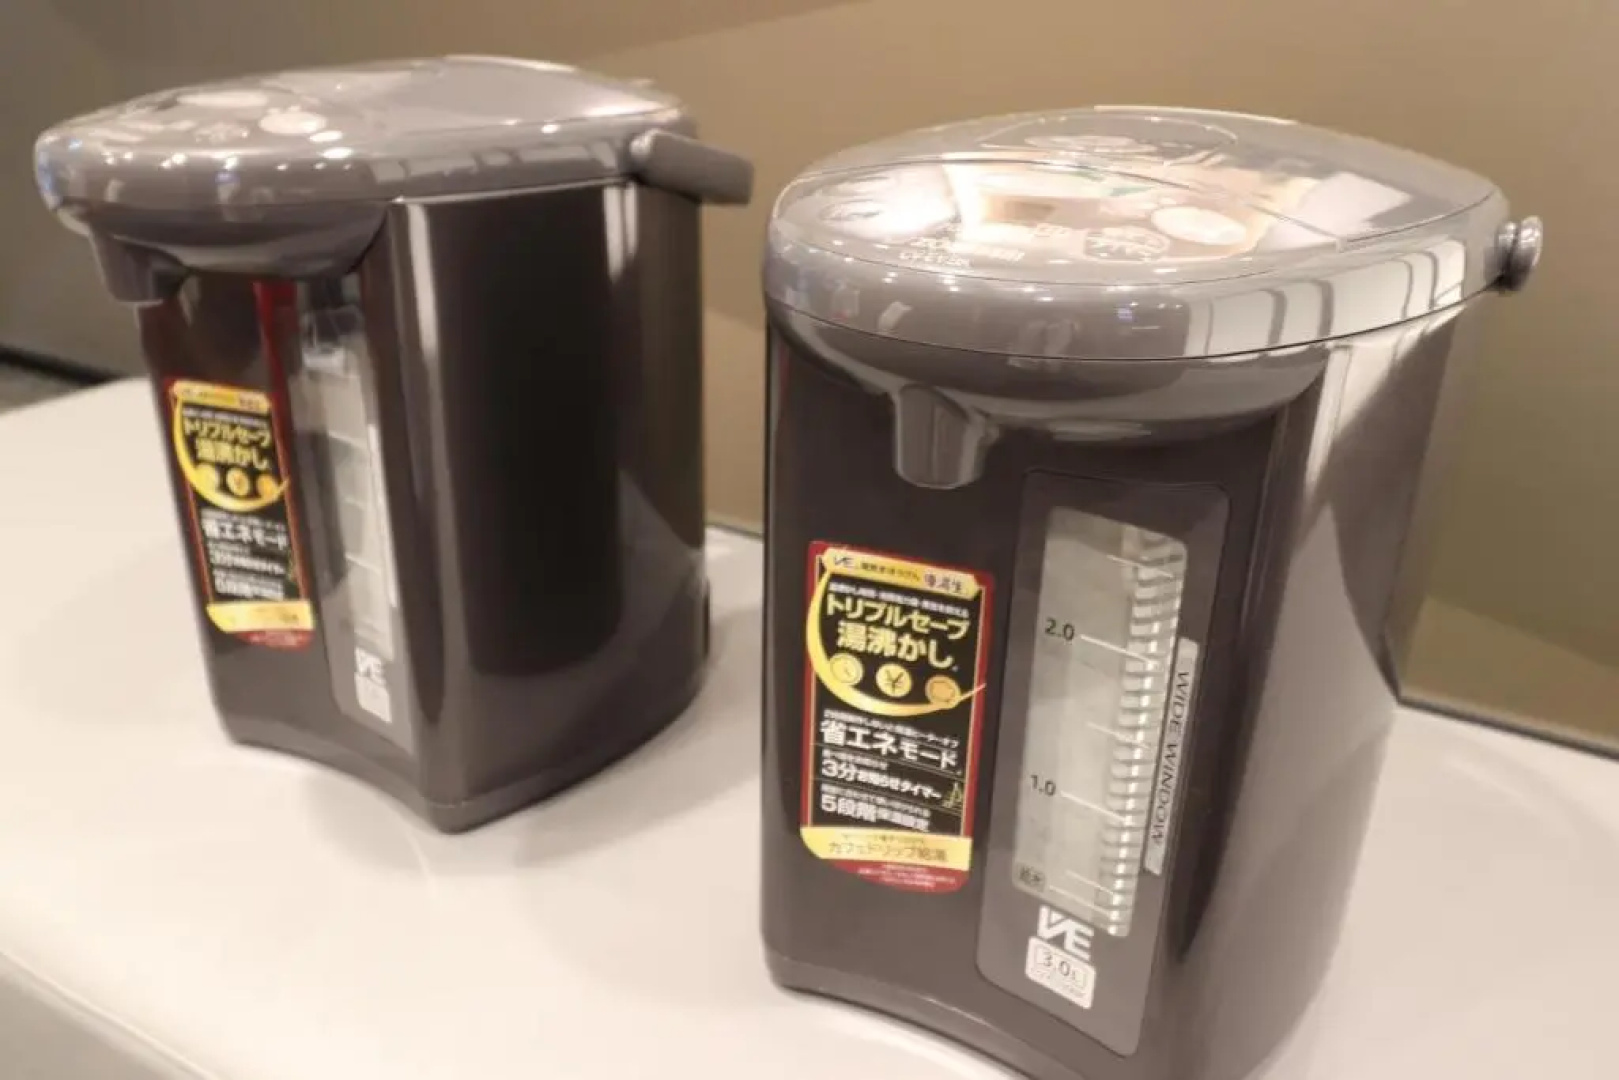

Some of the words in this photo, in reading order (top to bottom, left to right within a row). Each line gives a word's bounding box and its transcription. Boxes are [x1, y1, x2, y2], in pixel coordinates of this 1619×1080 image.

[837, 620, 953, 668] 湯沸かし
[1045, 617, 1075, 641] 2.0
[1168, 671, 1190, 734] WIDE
[820, 720, 958, 769] 省エネモード
[1031, 774, 1056, 797] 1.0
[1151, 743, 1179, 845] WINDOW
